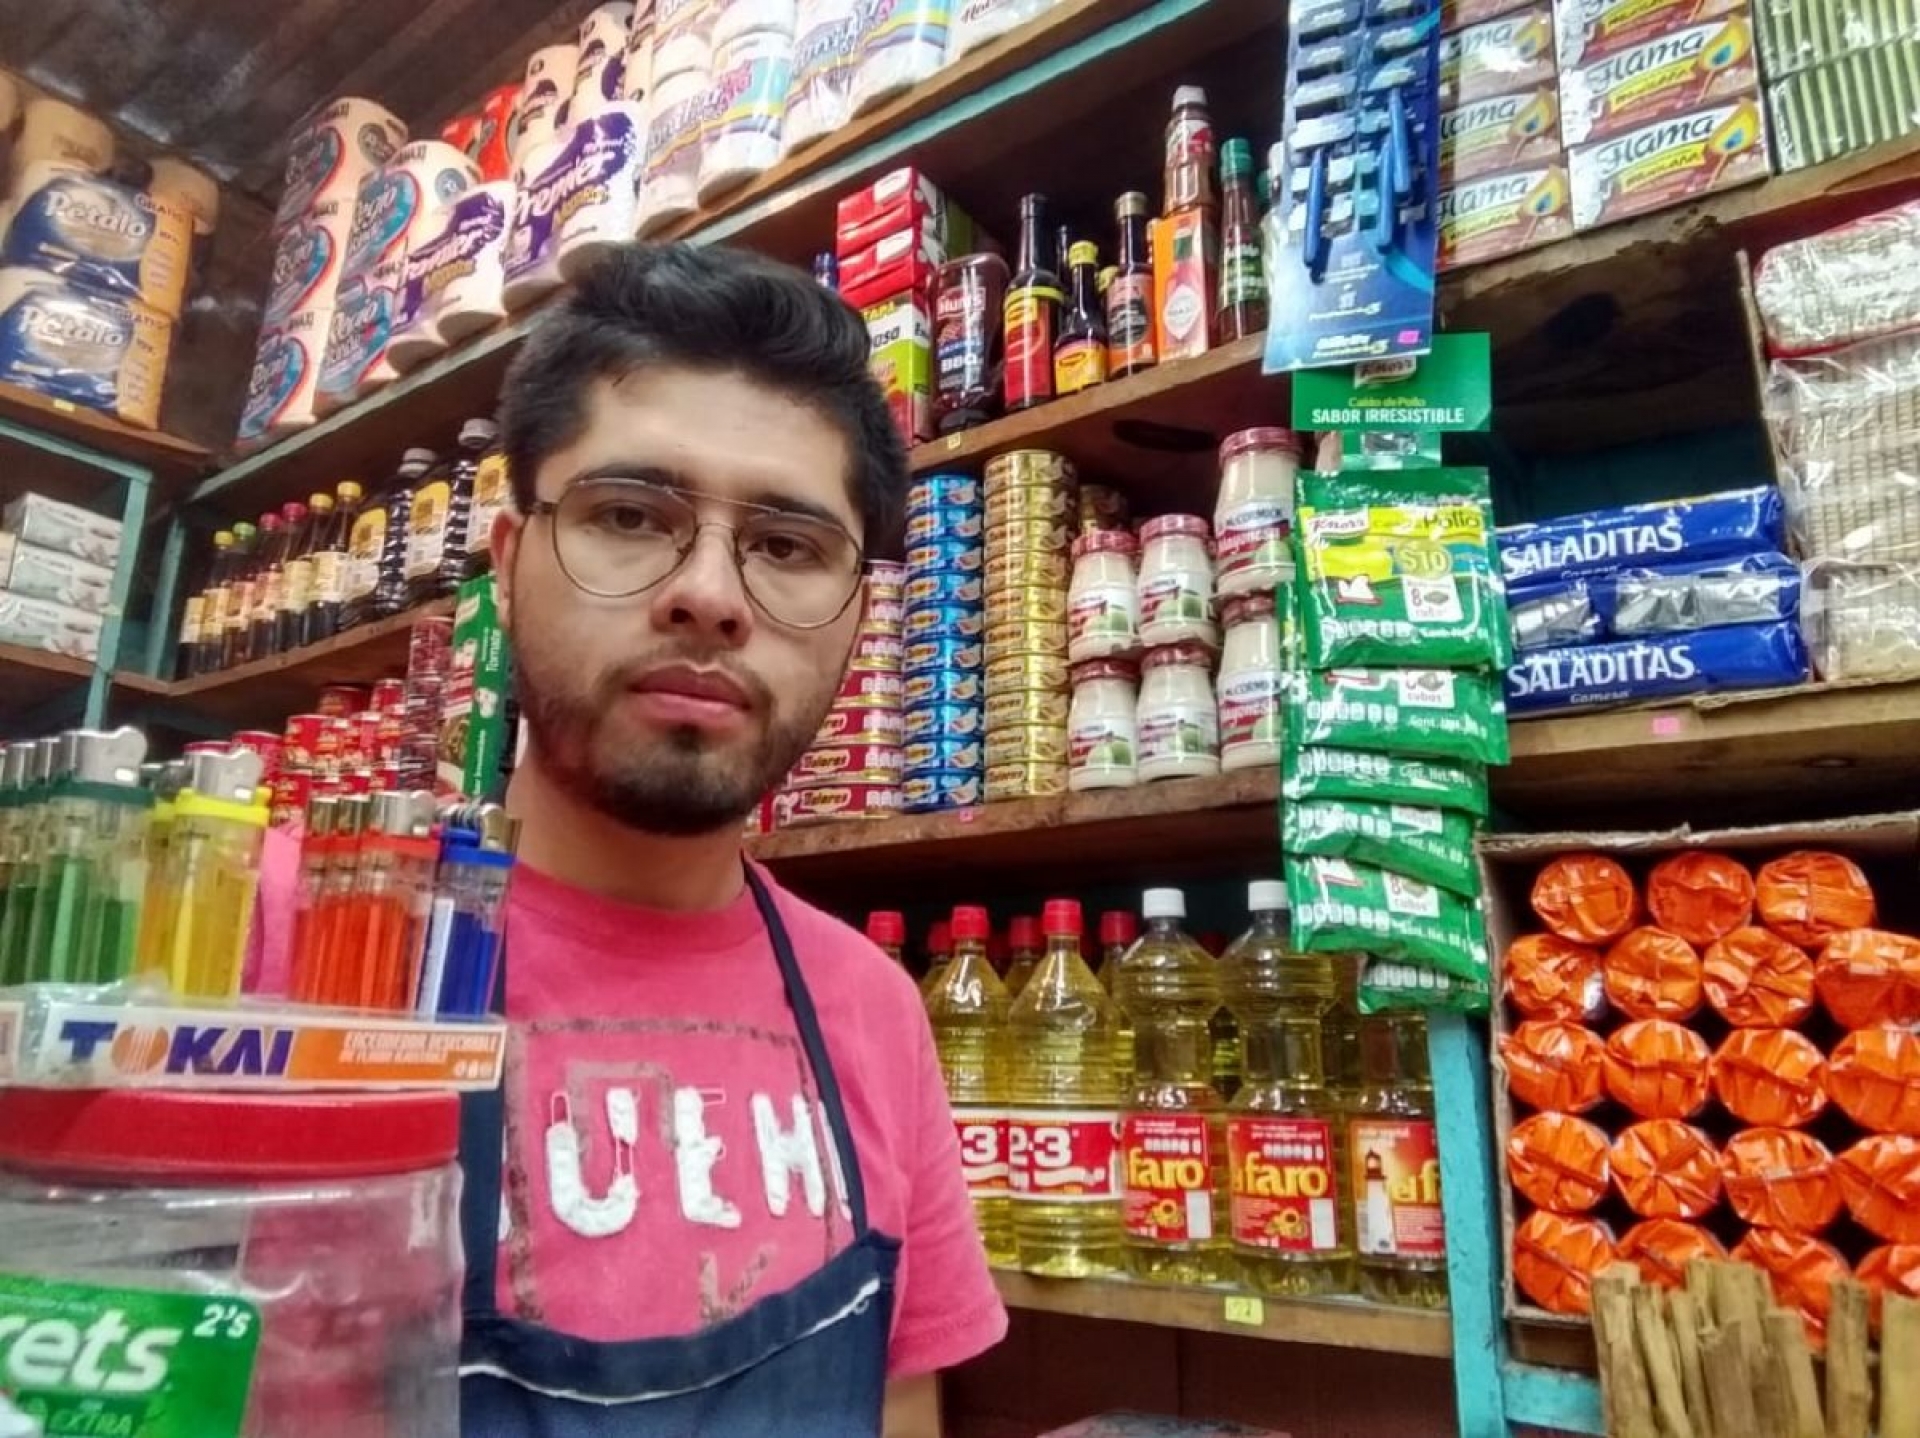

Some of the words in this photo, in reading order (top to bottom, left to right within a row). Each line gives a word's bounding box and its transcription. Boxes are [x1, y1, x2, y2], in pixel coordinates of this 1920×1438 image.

[1596, 115, 1714, 173] Flama
[1312, 408, 1361, 424] SABOR
[1365, 407, 1465, 424] IRRESISTIBLE
[1501, 522, 1683, 582] SALADITAS
[1507, 645, 1697, 697] SALADITAS
[1128, 1147, 1206, 1189] faro
[1245, 1151, 1328, 1198] faro
[192, 1304, 252, 1339] 2's
